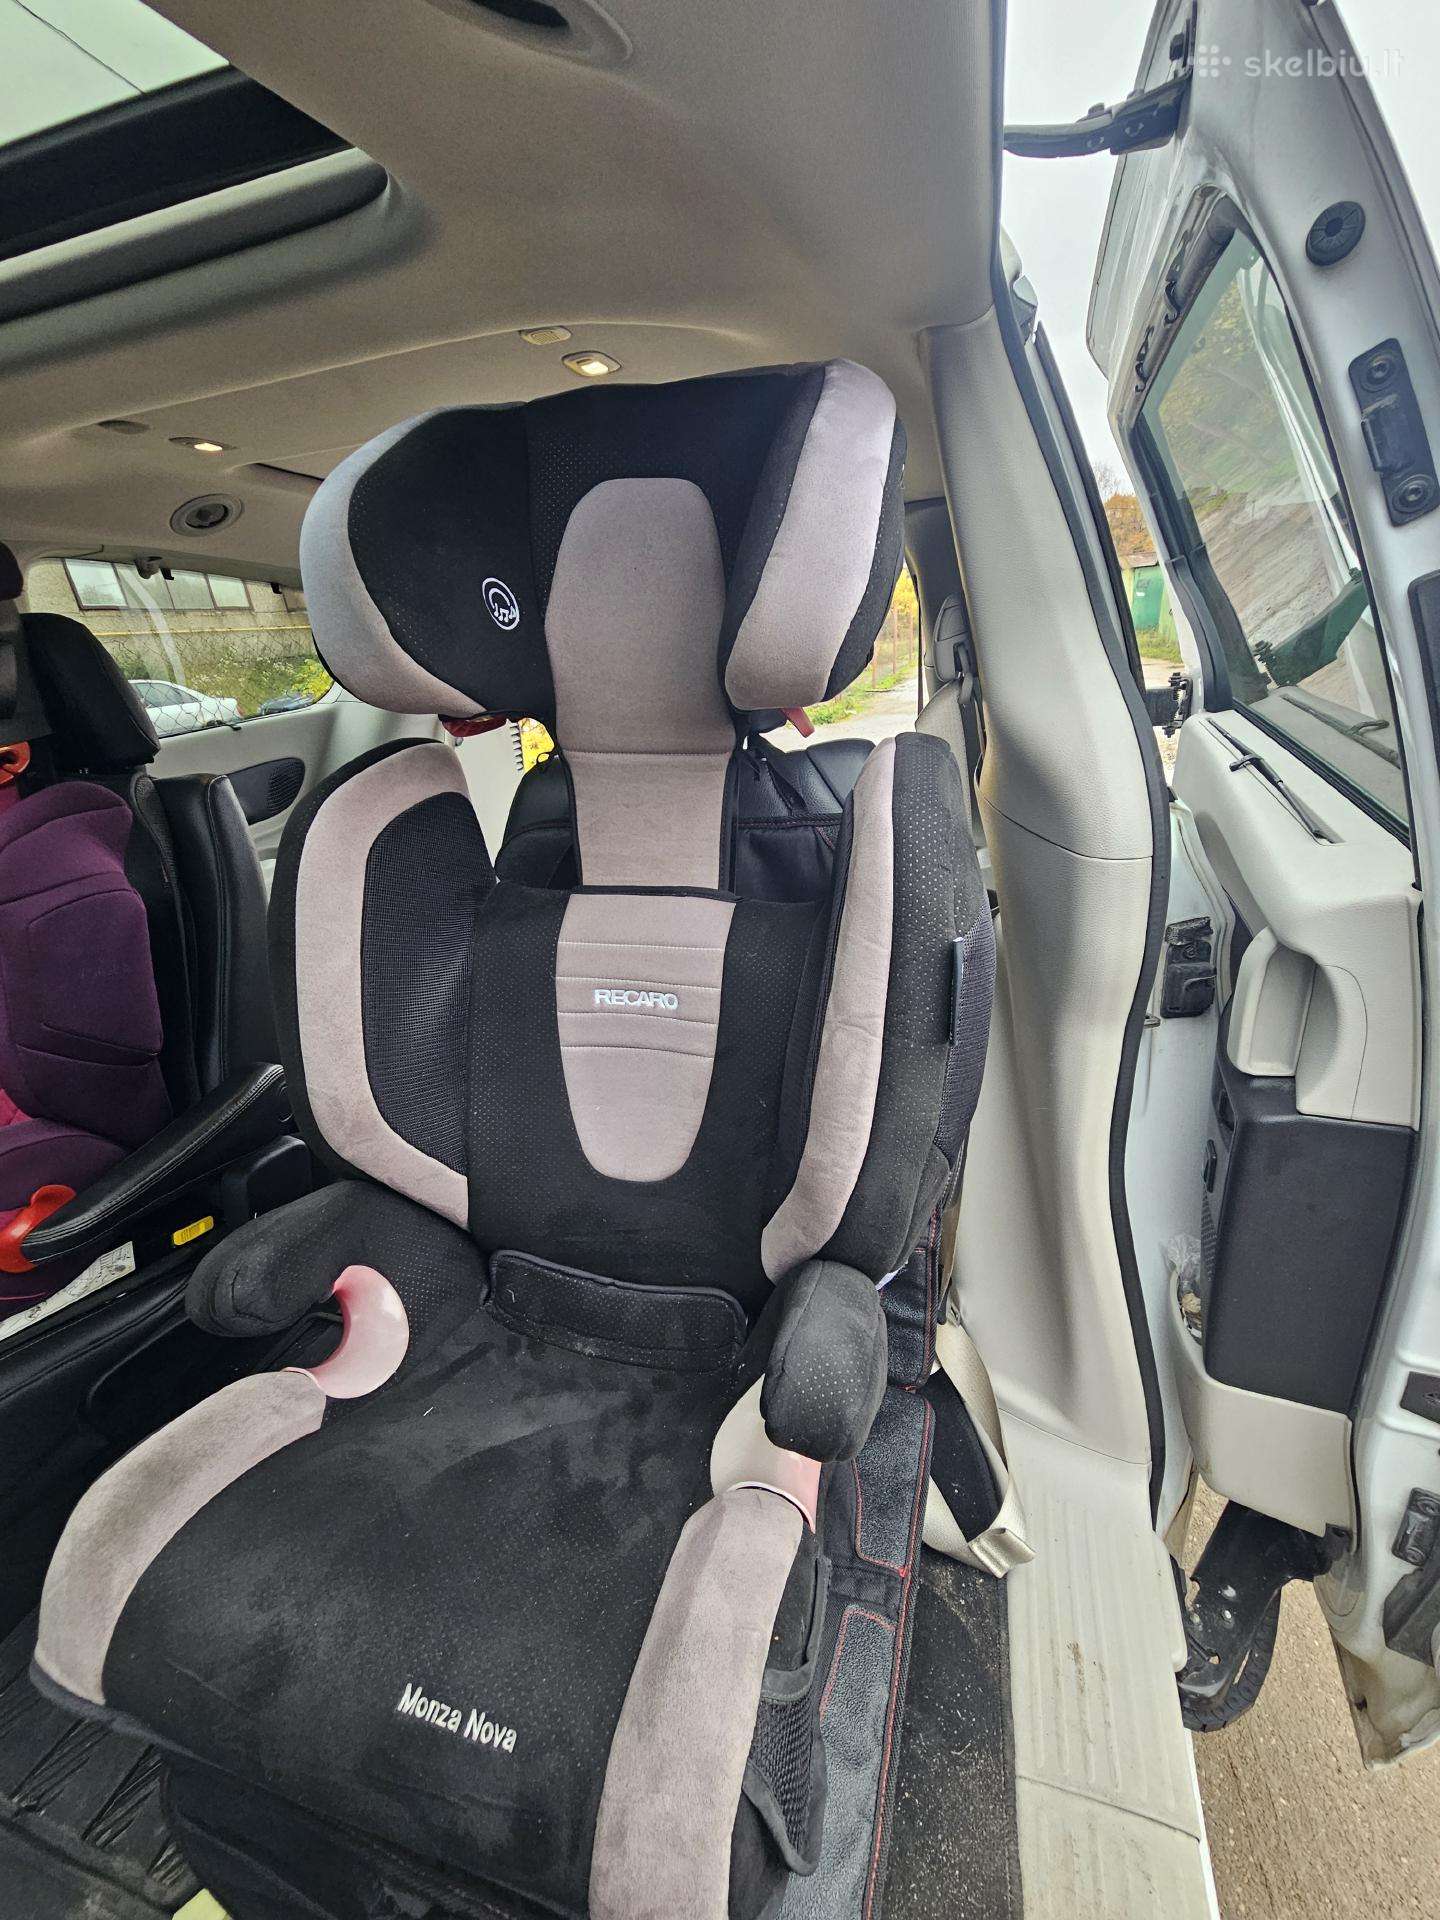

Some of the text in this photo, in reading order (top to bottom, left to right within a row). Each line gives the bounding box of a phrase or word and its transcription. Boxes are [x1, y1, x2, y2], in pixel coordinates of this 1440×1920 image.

[593, 988, 679, 1010] RECARO
[397, 1682, 517, 1753] Monza Nova
